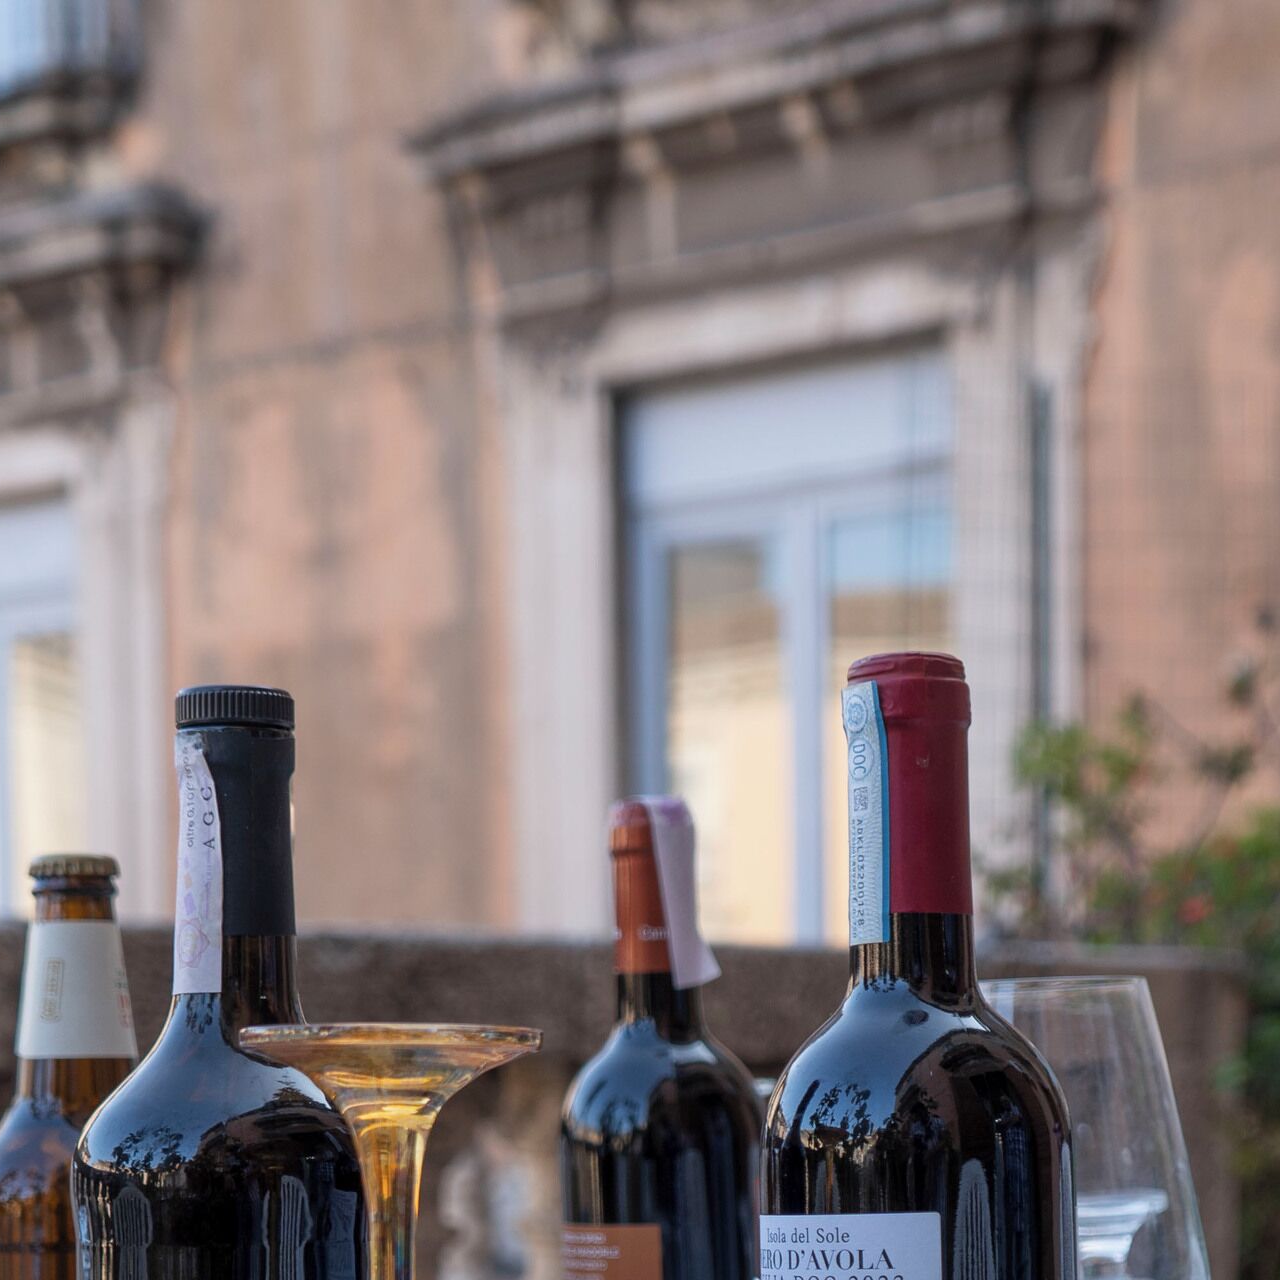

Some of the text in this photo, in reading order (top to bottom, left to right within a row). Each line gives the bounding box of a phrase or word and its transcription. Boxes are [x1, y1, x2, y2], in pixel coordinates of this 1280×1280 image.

[852, 743, 867, 775] DOC
[186, 820, 195, 848] oltre
[767, 1227, 850, 1243] Isola del Sole
[762, 1248, 896, 1271] ERO D'AVOLA
